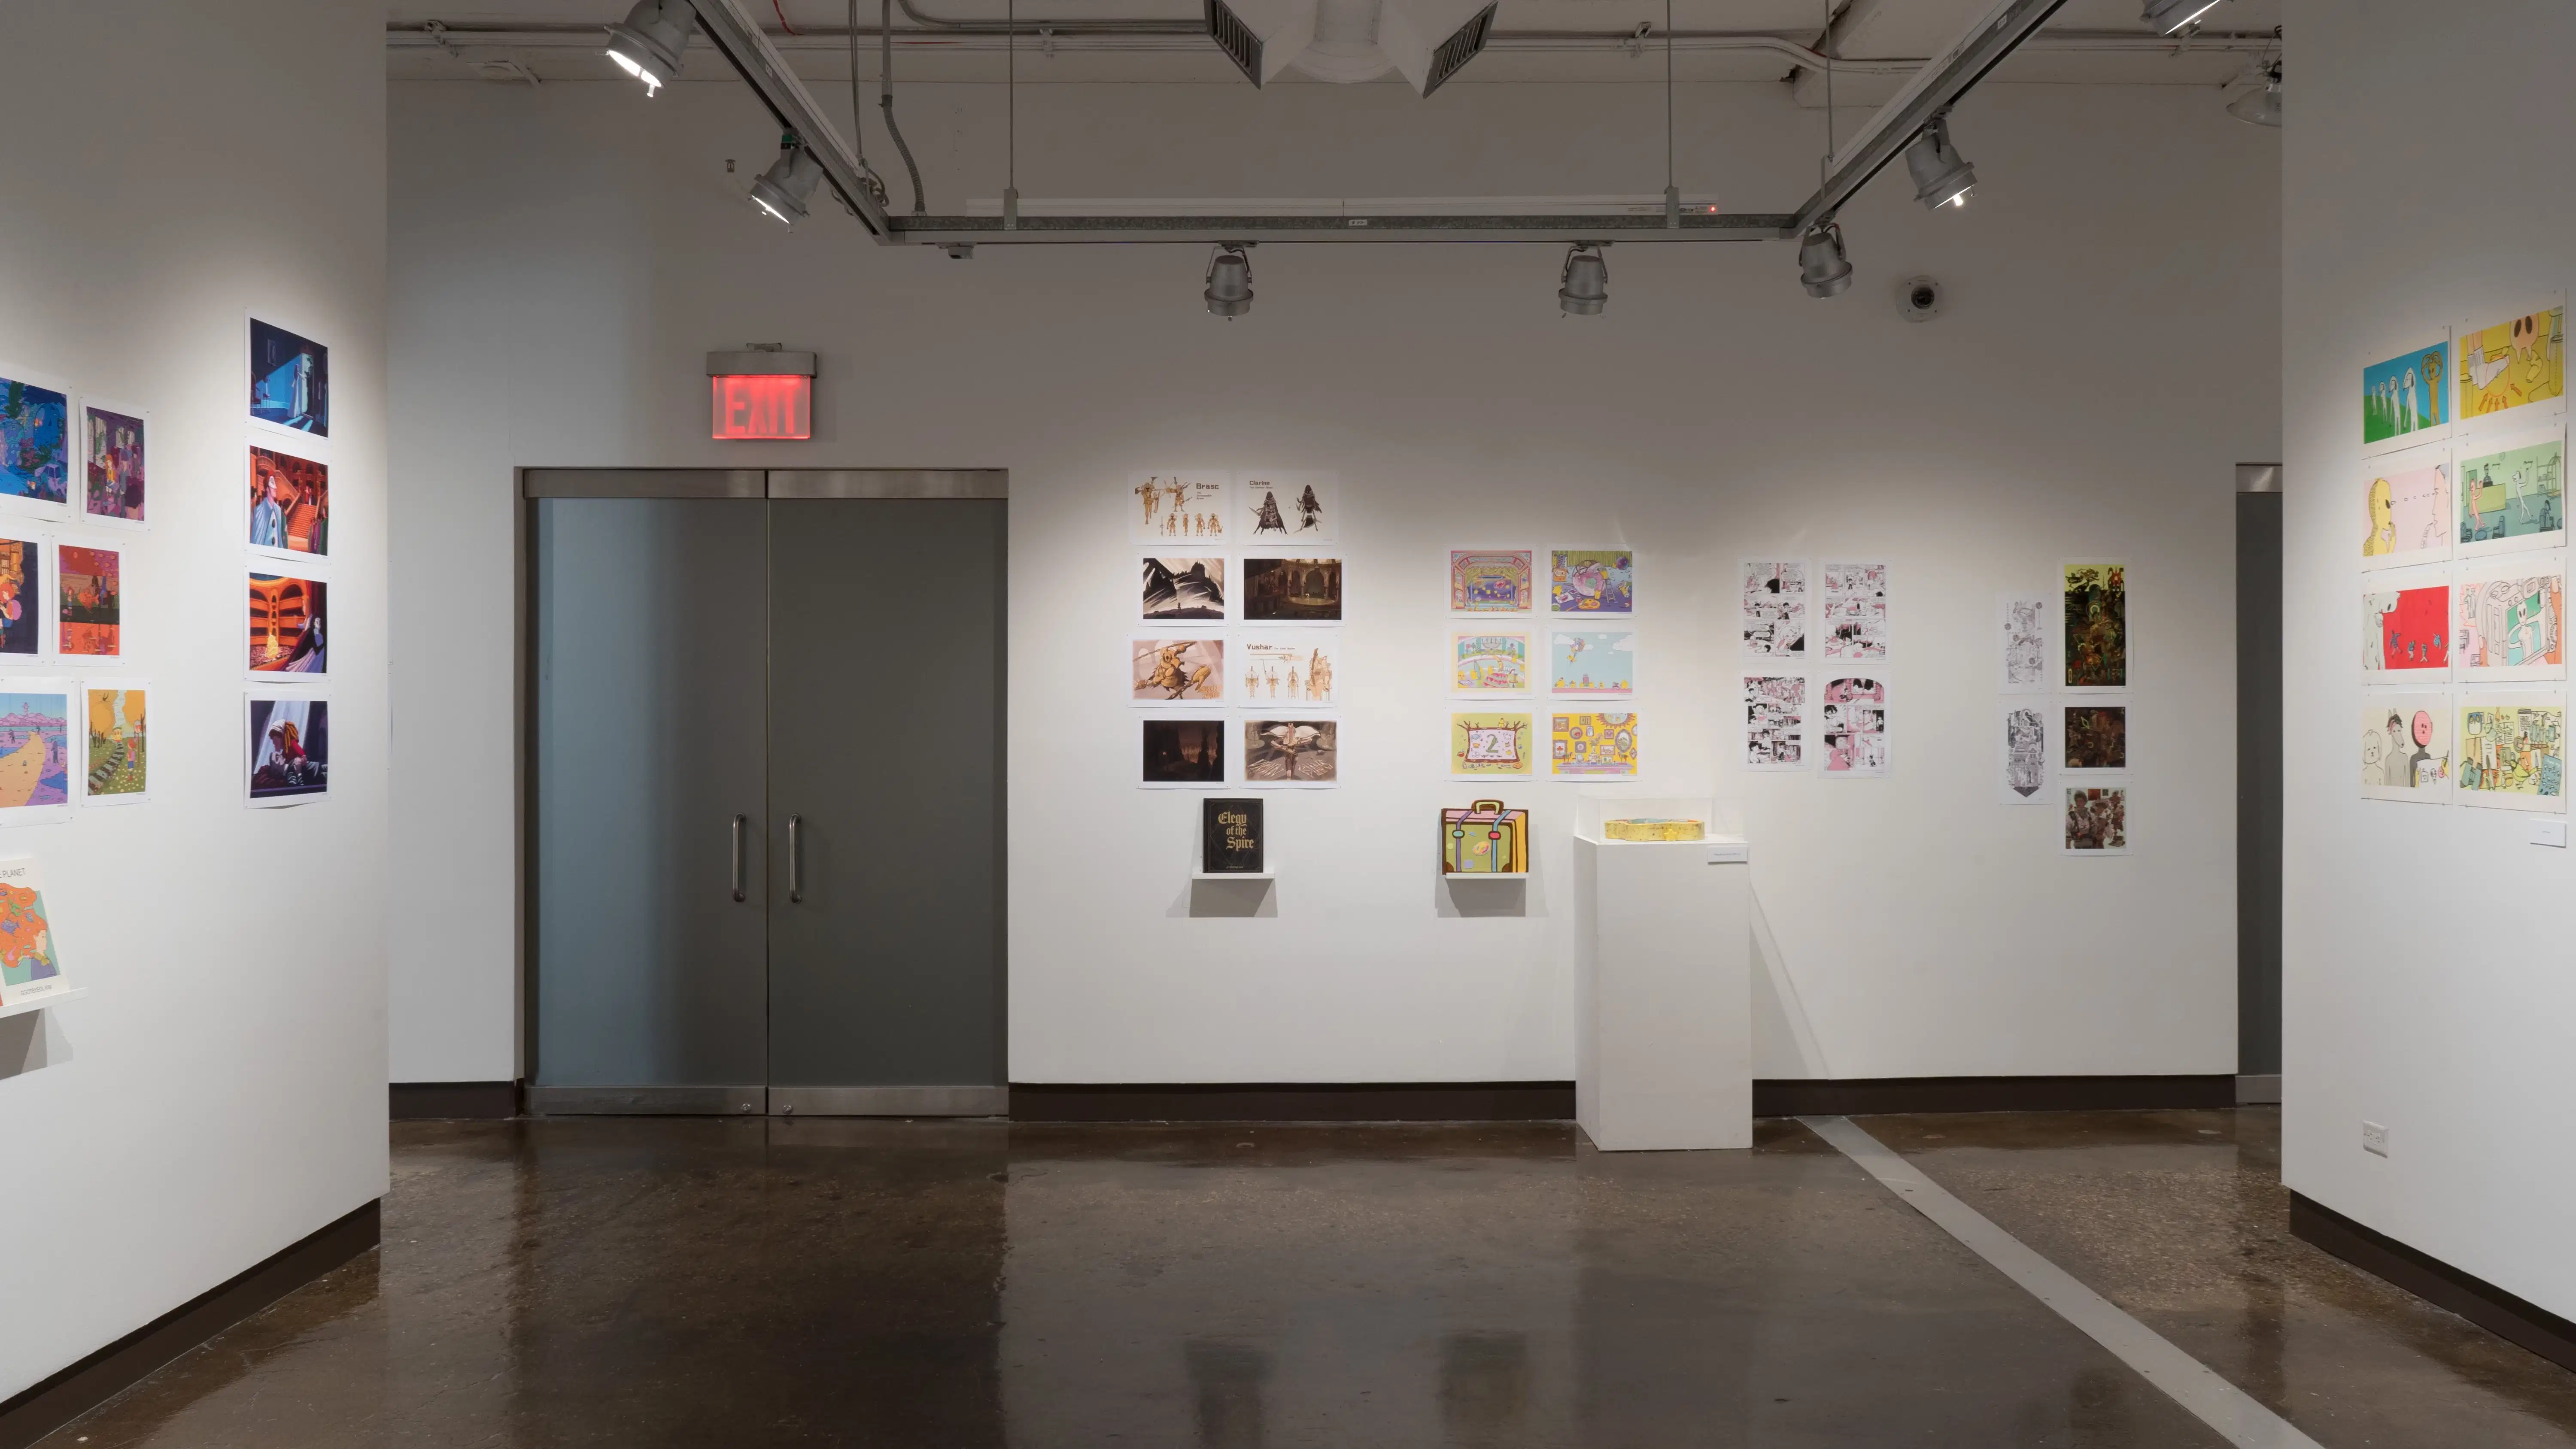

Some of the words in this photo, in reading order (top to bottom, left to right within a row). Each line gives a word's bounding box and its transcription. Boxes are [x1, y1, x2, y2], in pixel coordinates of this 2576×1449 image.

[726, 379, 799, 434] EXIT
[1218, 810, 1247, 826] Elegy
[1226, 826, 1235, 835] of
[1235, 825, 1247, 837] the
[1226, 836, 1254, 852] Spire
[2, 868, 25, 878] PLANET
